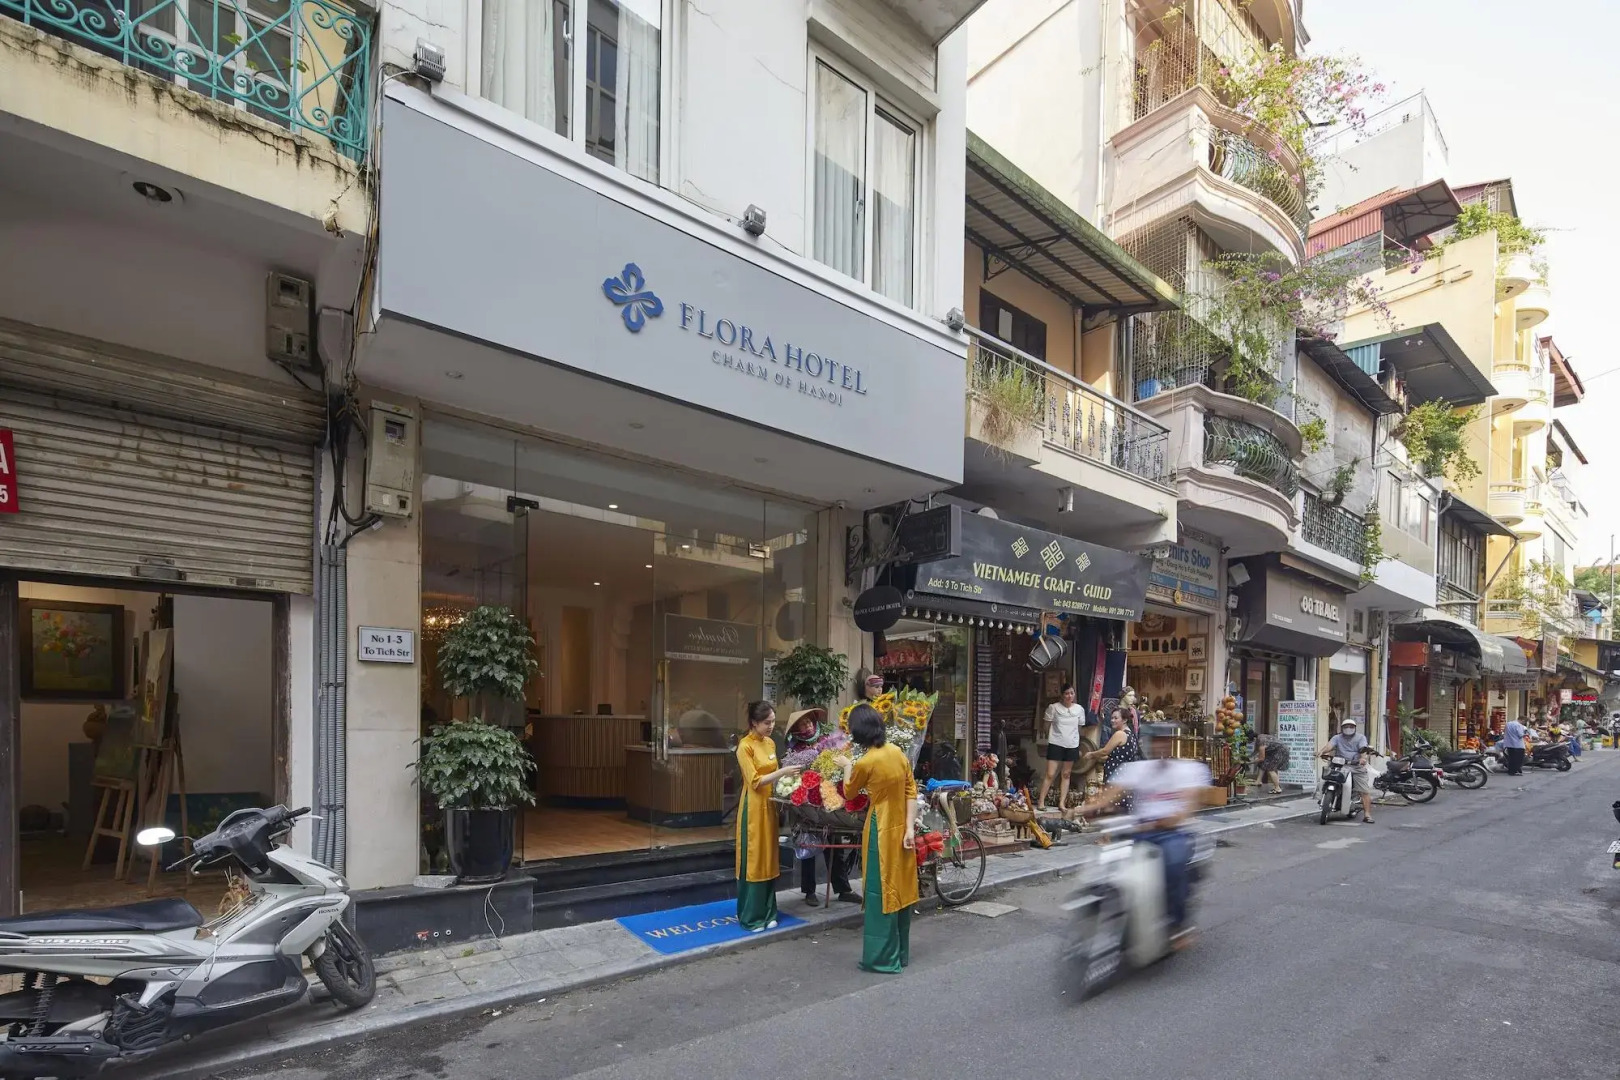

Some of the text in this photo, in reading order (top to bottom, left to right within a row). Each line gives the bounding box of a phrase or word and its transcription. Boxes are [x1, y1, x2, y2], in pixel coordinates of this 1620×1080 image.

[678, 301, 868, 396] FLORA HOTEL
[712, 350, 843, 407] CHARM OF HANOI
[1191, 548, 1211, 570] Shop
[927, 578, 943, 588] Add:
[945, 581, 949, 589] 3
[951, 581, 958, 590] To
[973, 561, 1042, 589] VIETNAMESE
[1043, 576, 1076, 594] CRAFT
[1083, 583, 1112, 600] GUILD
[1314, 599, 1340, 622] TRAVEL
[371, 634, 385, 643] No
[363, 646, 410, 657] To Tich Str
[1280, 723, 1296, 732] SAPA
[644, 915, 740, 939] WELCOM
